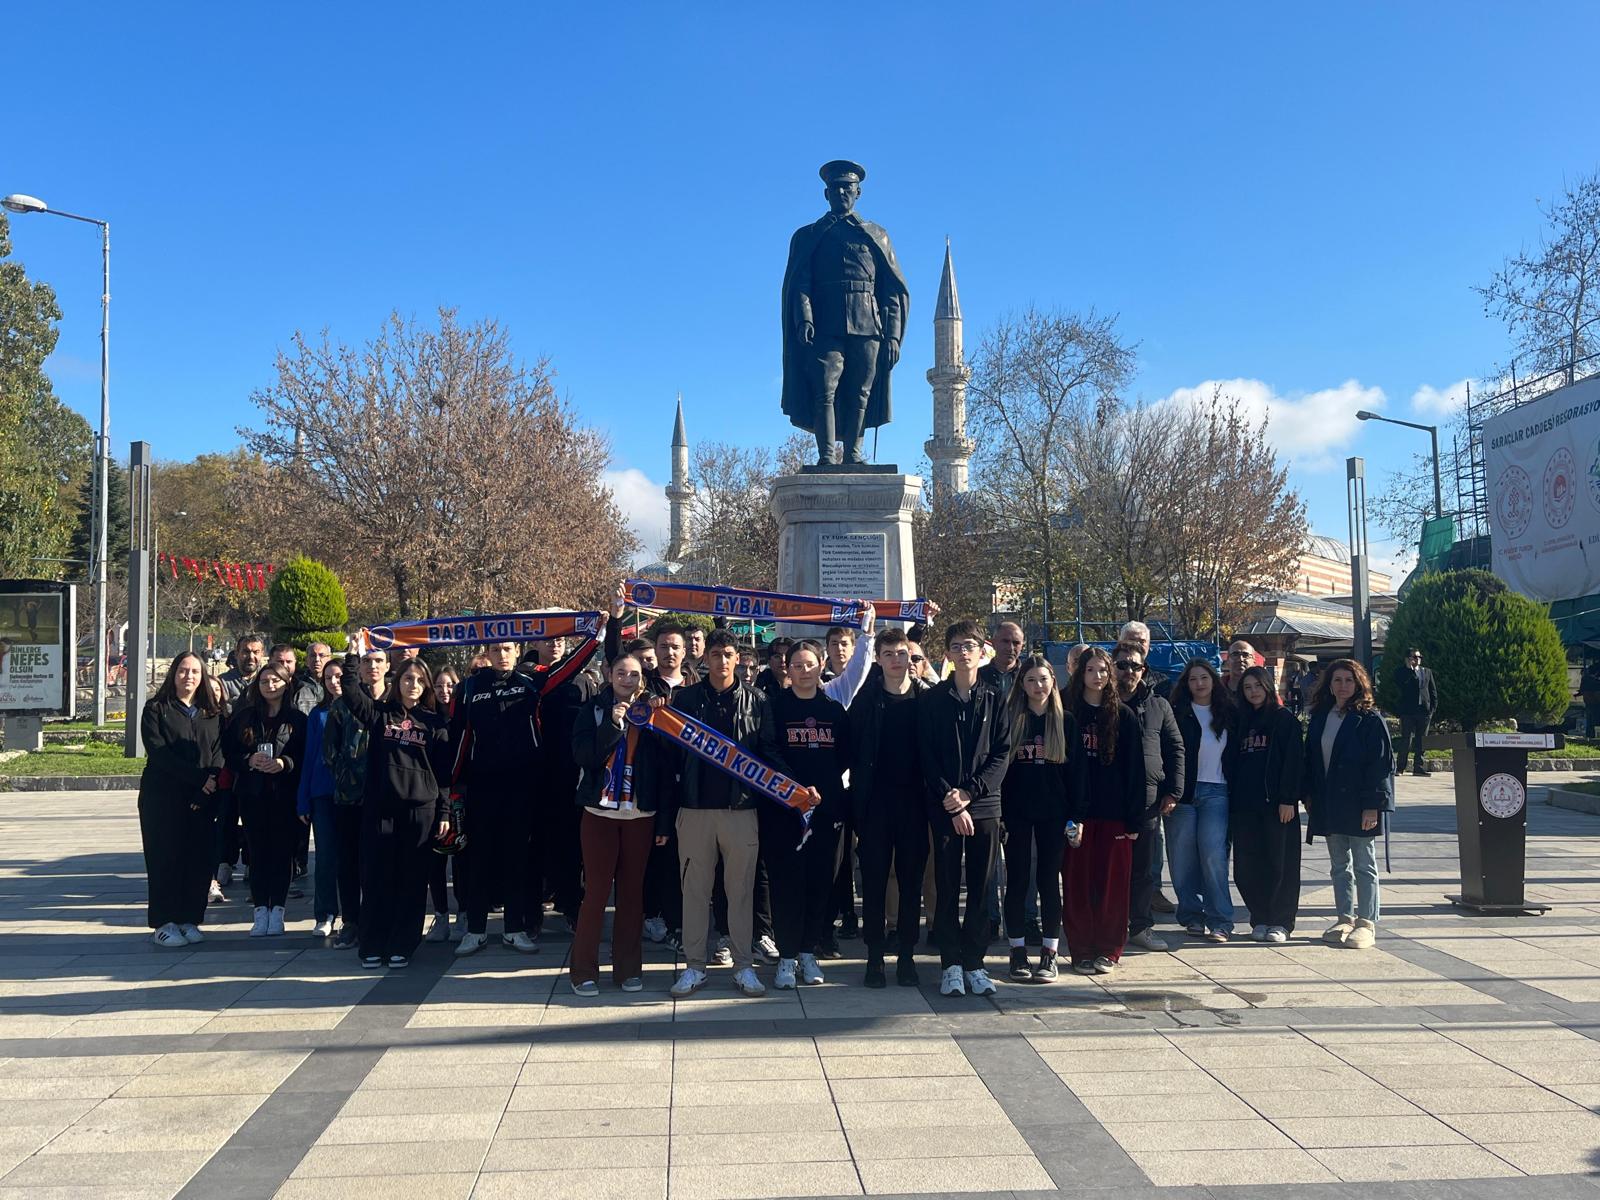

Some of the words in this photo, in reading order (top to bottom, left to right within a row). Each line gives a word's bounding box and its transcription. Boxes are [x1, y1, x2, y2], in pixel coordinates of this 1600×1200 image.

[713, 592, 775, 617] EYBAL
[427, 622, 478, 642] BABA
[482, 617, 547, 639] KOLEJ
[9, 653, 50, 666] NEFES
[787, 728, 835, 742] EYBAL
[679, 720, 731, 766] BABA
[729, 752, 798, 801] KOLEJ
[1017, 745, 1048, 760] EYB
